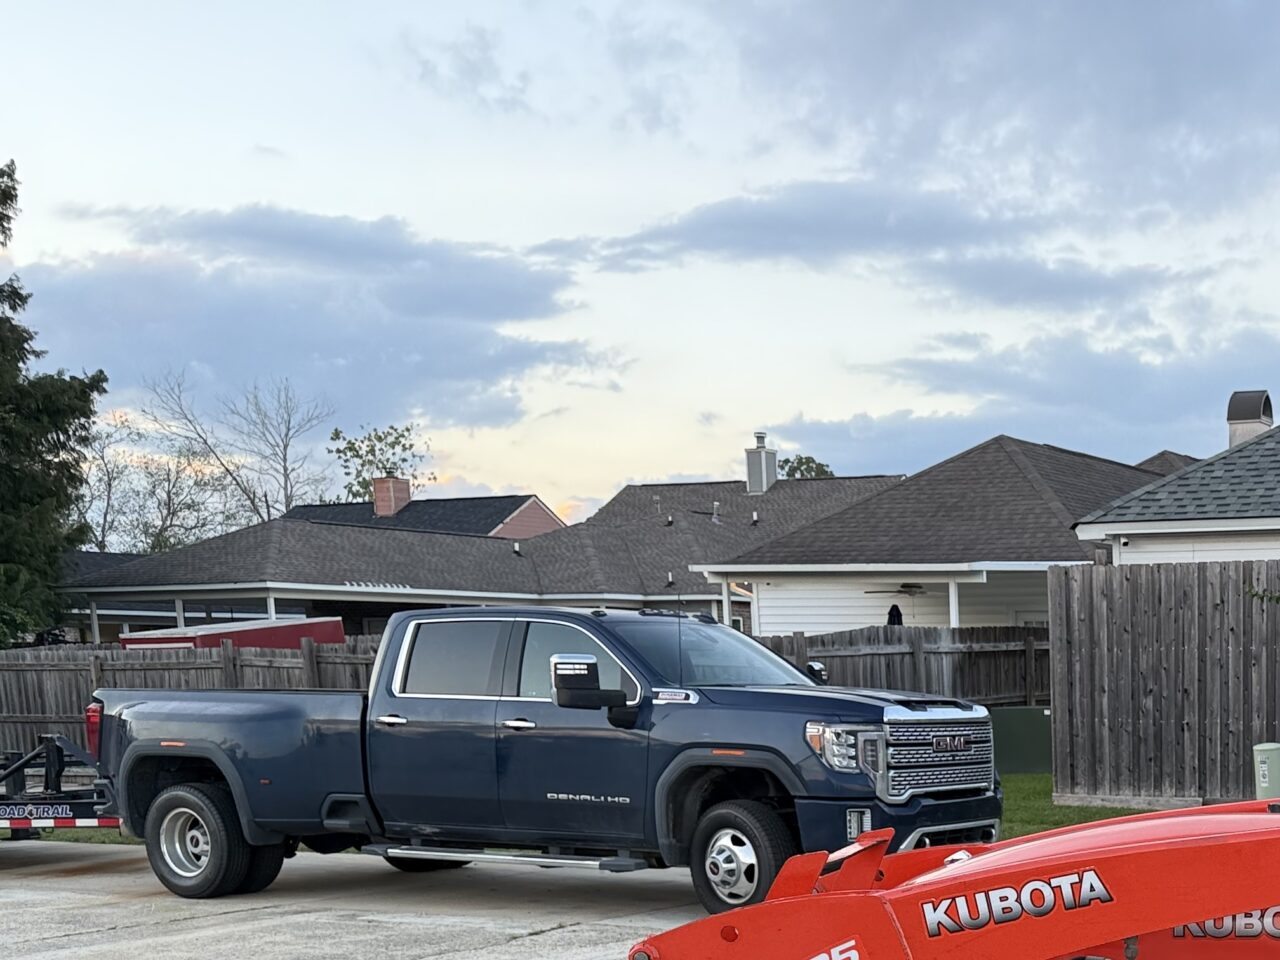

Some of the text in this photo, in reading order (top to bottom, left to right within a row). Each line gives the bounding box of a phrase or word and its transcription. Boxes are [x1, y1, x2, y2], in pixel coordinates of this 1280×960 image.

[933, 736, 972, 751] GMC
[546, 792, 631, 804] DENALI HD
[34, 805, 73, 817] TRAIL
[921, 869, 1114, 937] KUBOTA
